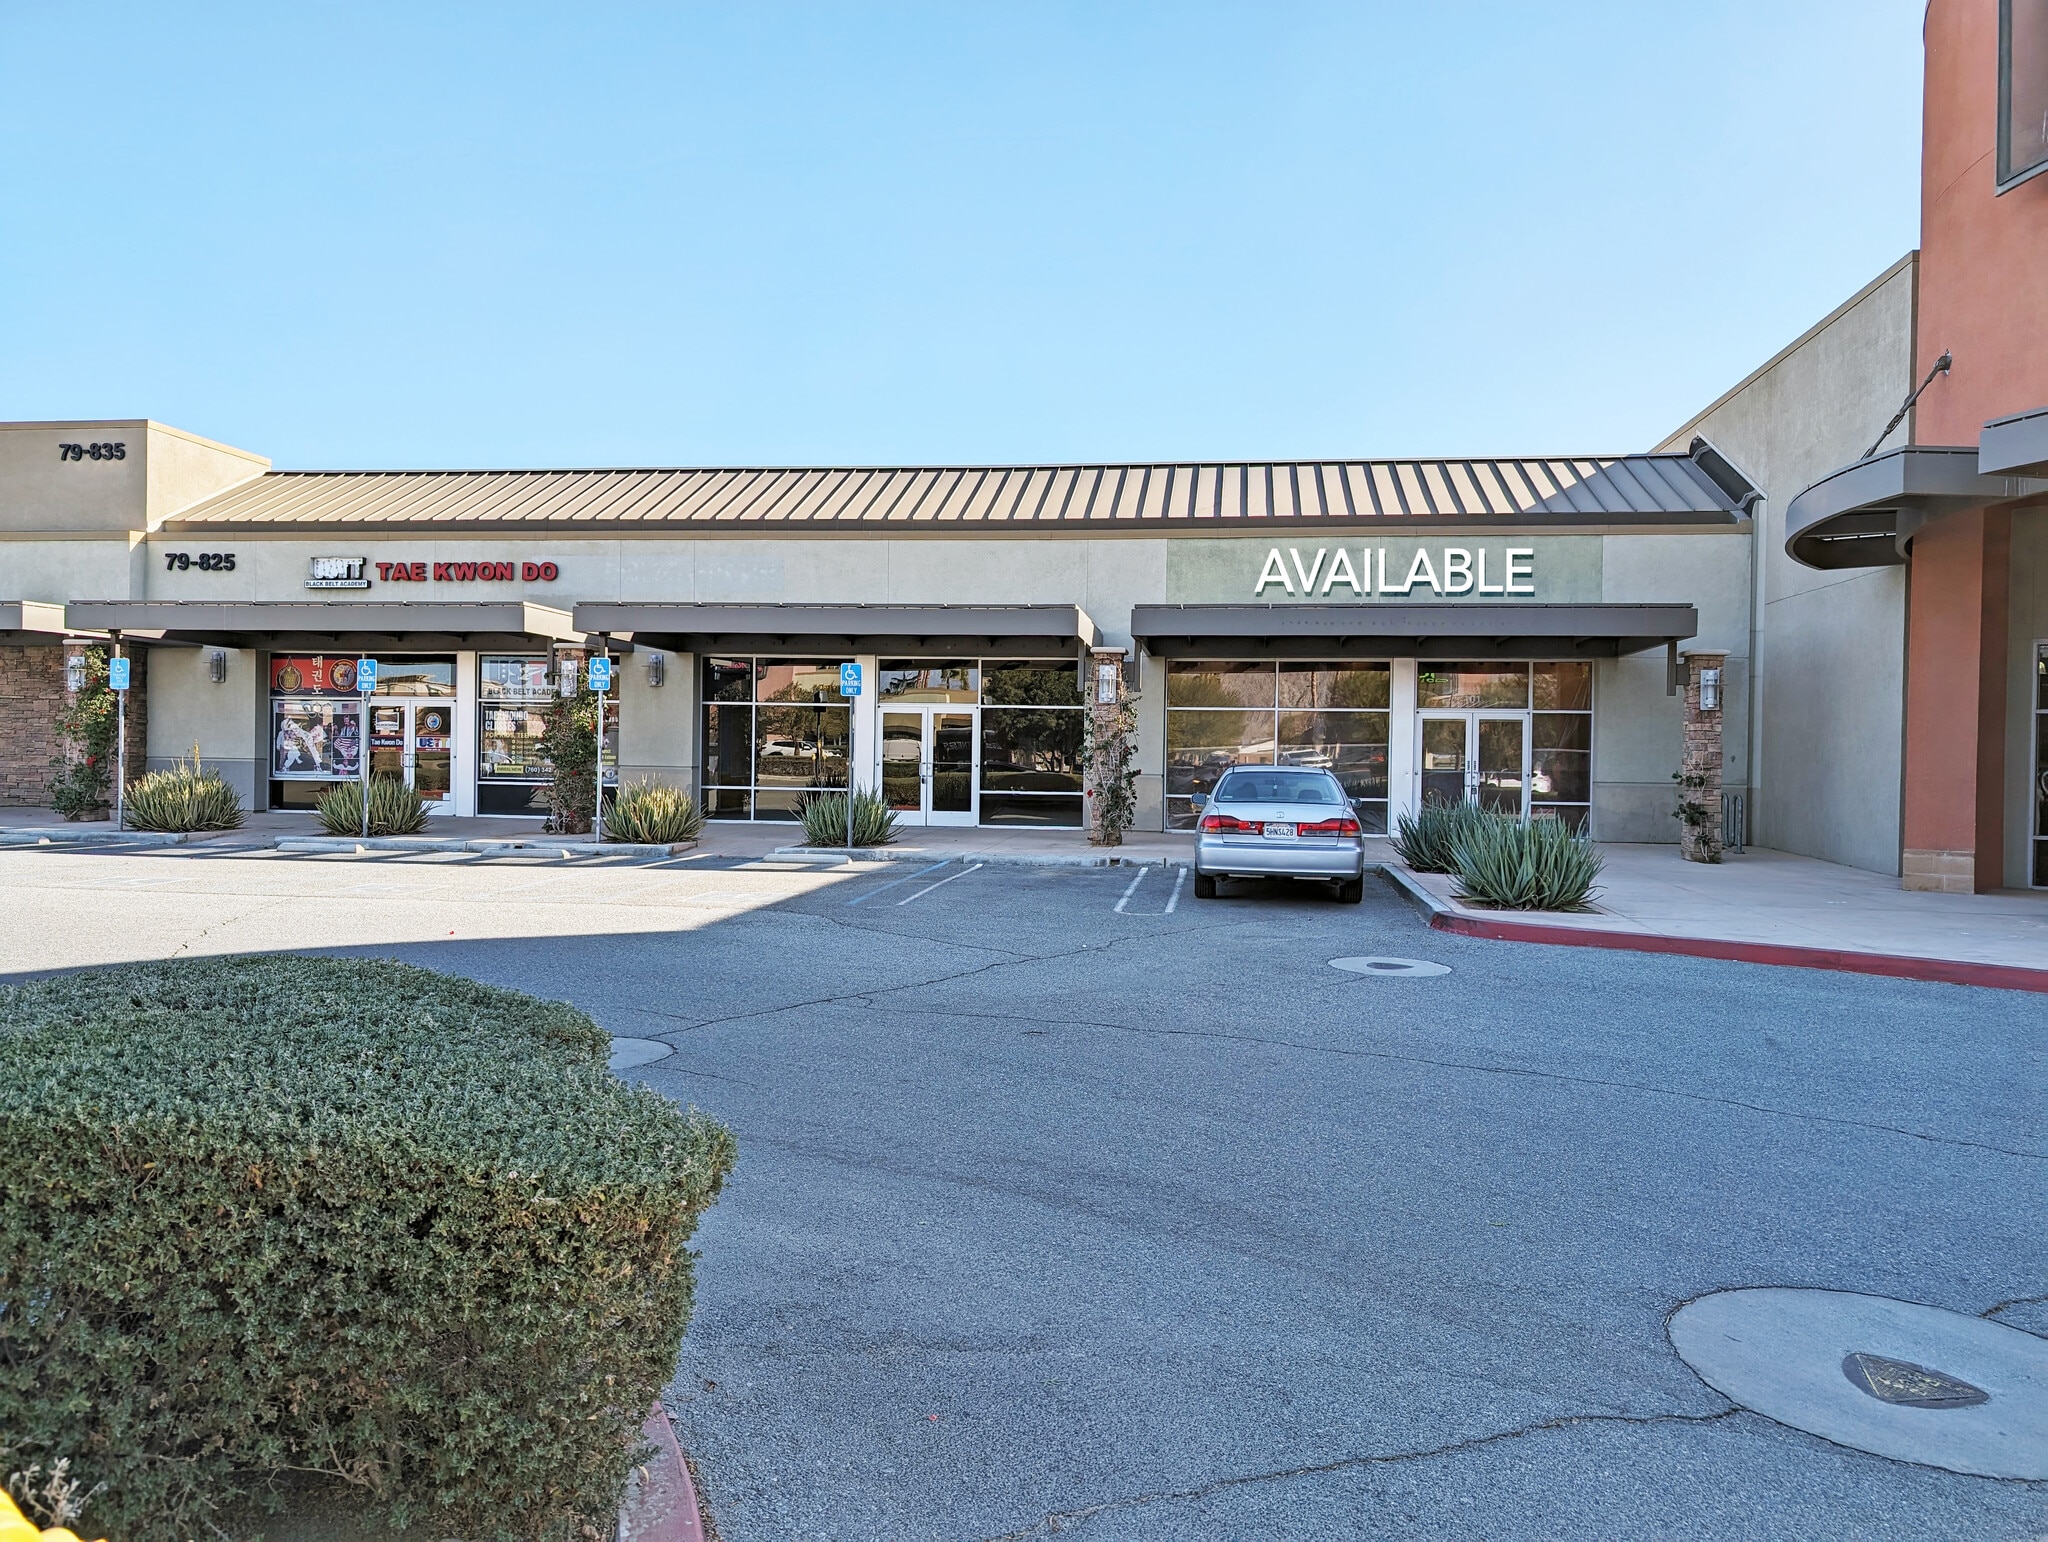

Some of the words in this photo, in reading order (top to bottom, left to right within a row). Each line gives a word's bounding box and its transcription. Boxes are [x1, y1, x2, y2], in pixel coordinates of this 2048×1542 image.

[59, 443, 126, 461] 79-835
[165, 553, 236, 571] 79-825
[376, 562, 427, 581] TAE
[433, 562, 514, 581] KWON
[522, 562, 559, 581] DO
[1254, 548, 1535, 597] AVAILABLE
[371, 738, 381, 746] Tae
[381, 738, 395, 746] Kwon
[396, 738, 404, 746] Do
[525, 765, 541, 774] (760)
